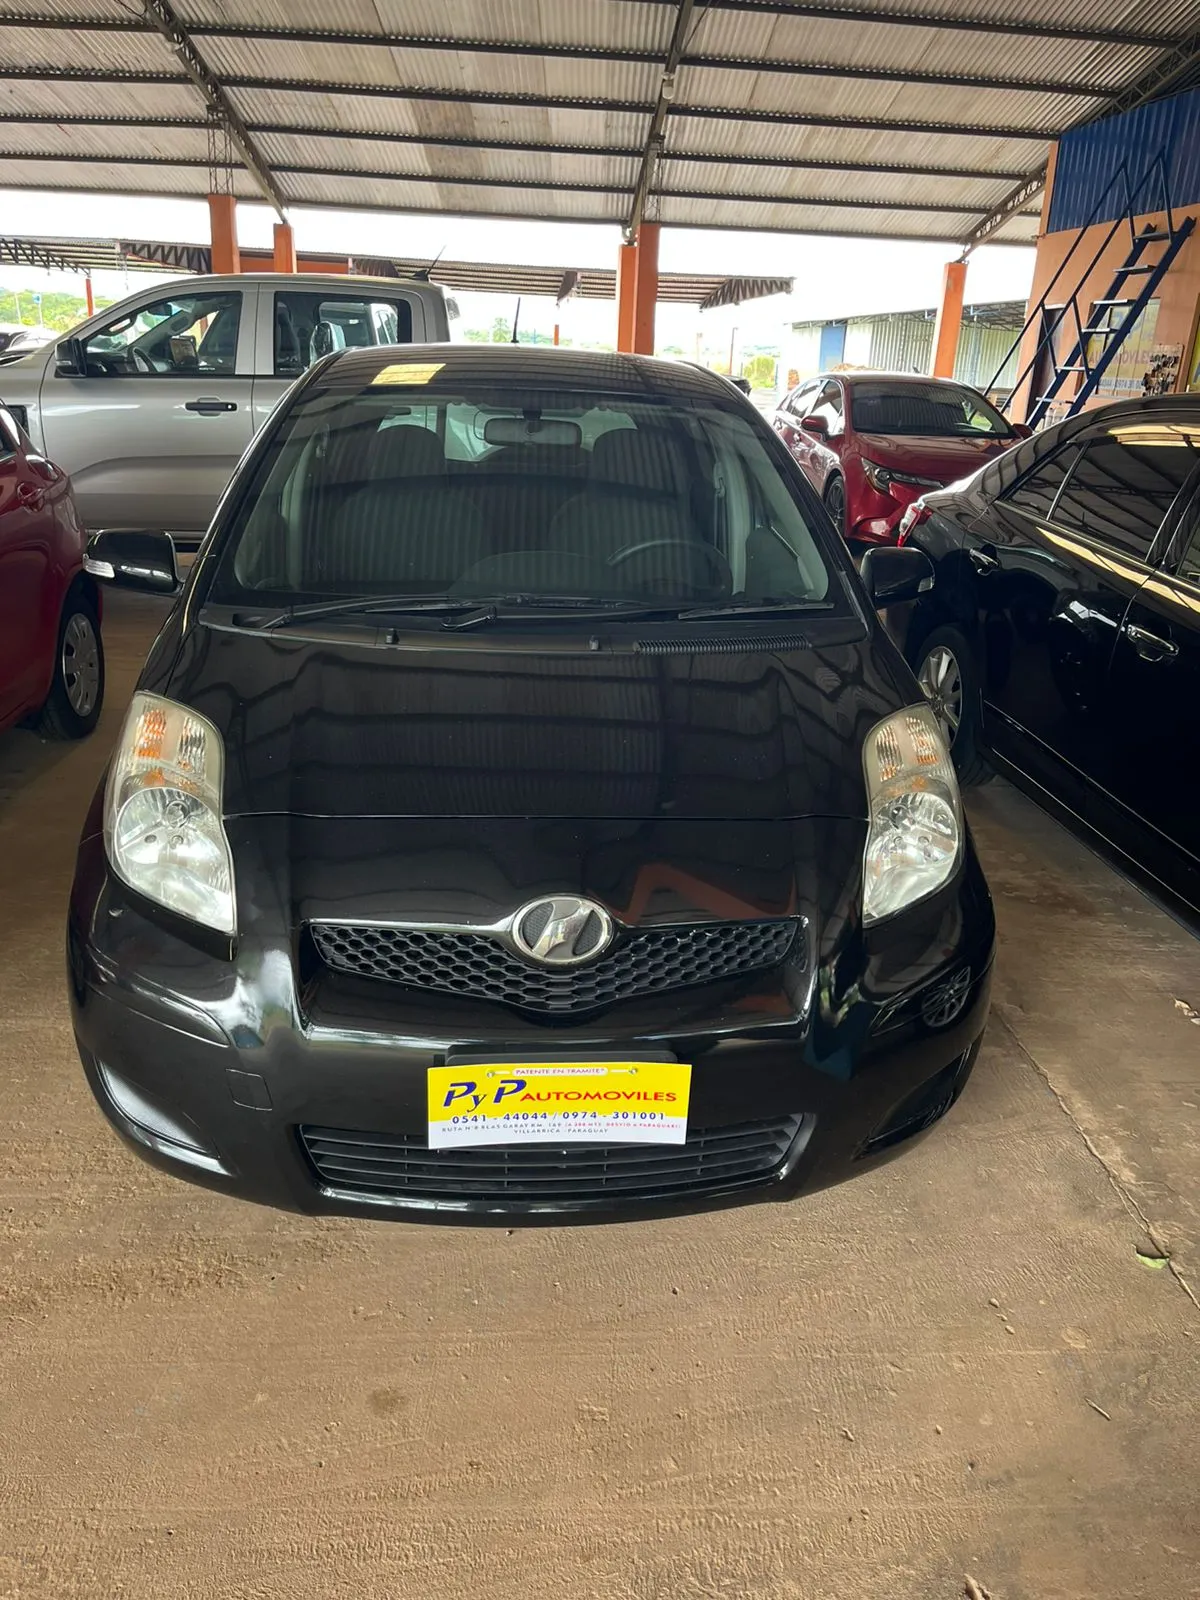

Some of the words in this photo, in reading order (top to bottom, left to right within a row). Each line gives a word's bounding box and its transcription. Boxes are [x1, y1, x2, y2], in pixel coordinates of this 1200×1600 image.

[520, 1091, 677, 1102] AUTOMOVILES
[452, 1114, 486, 1124] 0541
[504, 1112, 547, 1121] 44044
[563, 1111, 597, 1119] 0974
[612, 1111, 664, 1120] 301001
